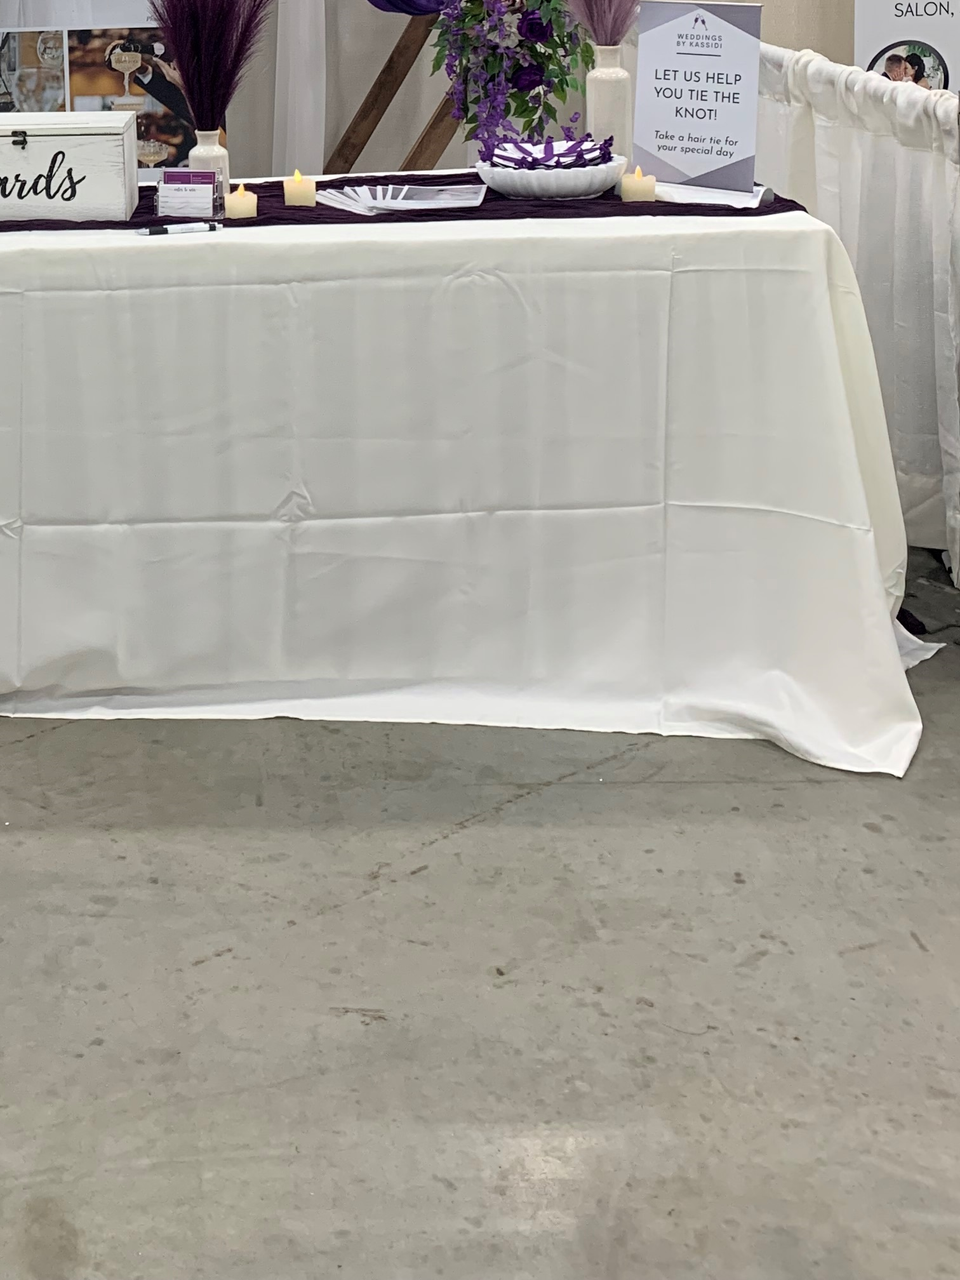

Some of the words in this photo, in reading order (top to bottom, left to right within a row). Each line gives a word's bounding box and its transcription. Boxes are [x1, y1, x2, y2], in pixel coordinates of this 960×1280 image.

[894, 1, 955, 18] SALON,
[677, 33, 723, 42] WEDDINGS
[655, 69, 679, 82] LET
[683, 71, 701, 83] US
[706, 72, 742, 86] HELP
[654, 87, 683, 100] YOU
[688, 89, 708, 102] TIE
[713, 91, 740, 104] THE
[674, 107, 718, 121] KNOT!
[654, 130, 676, 142] Take
[678, 134, 685, 142] a
[687, 132, 707, 144] hair
[710, 135, 722, 145] tie
[725, 136, 739, 147] for
[657, 144, 677, 154] your
[680, 144, 714, 156] special
[716, 147, 735, 159] day
